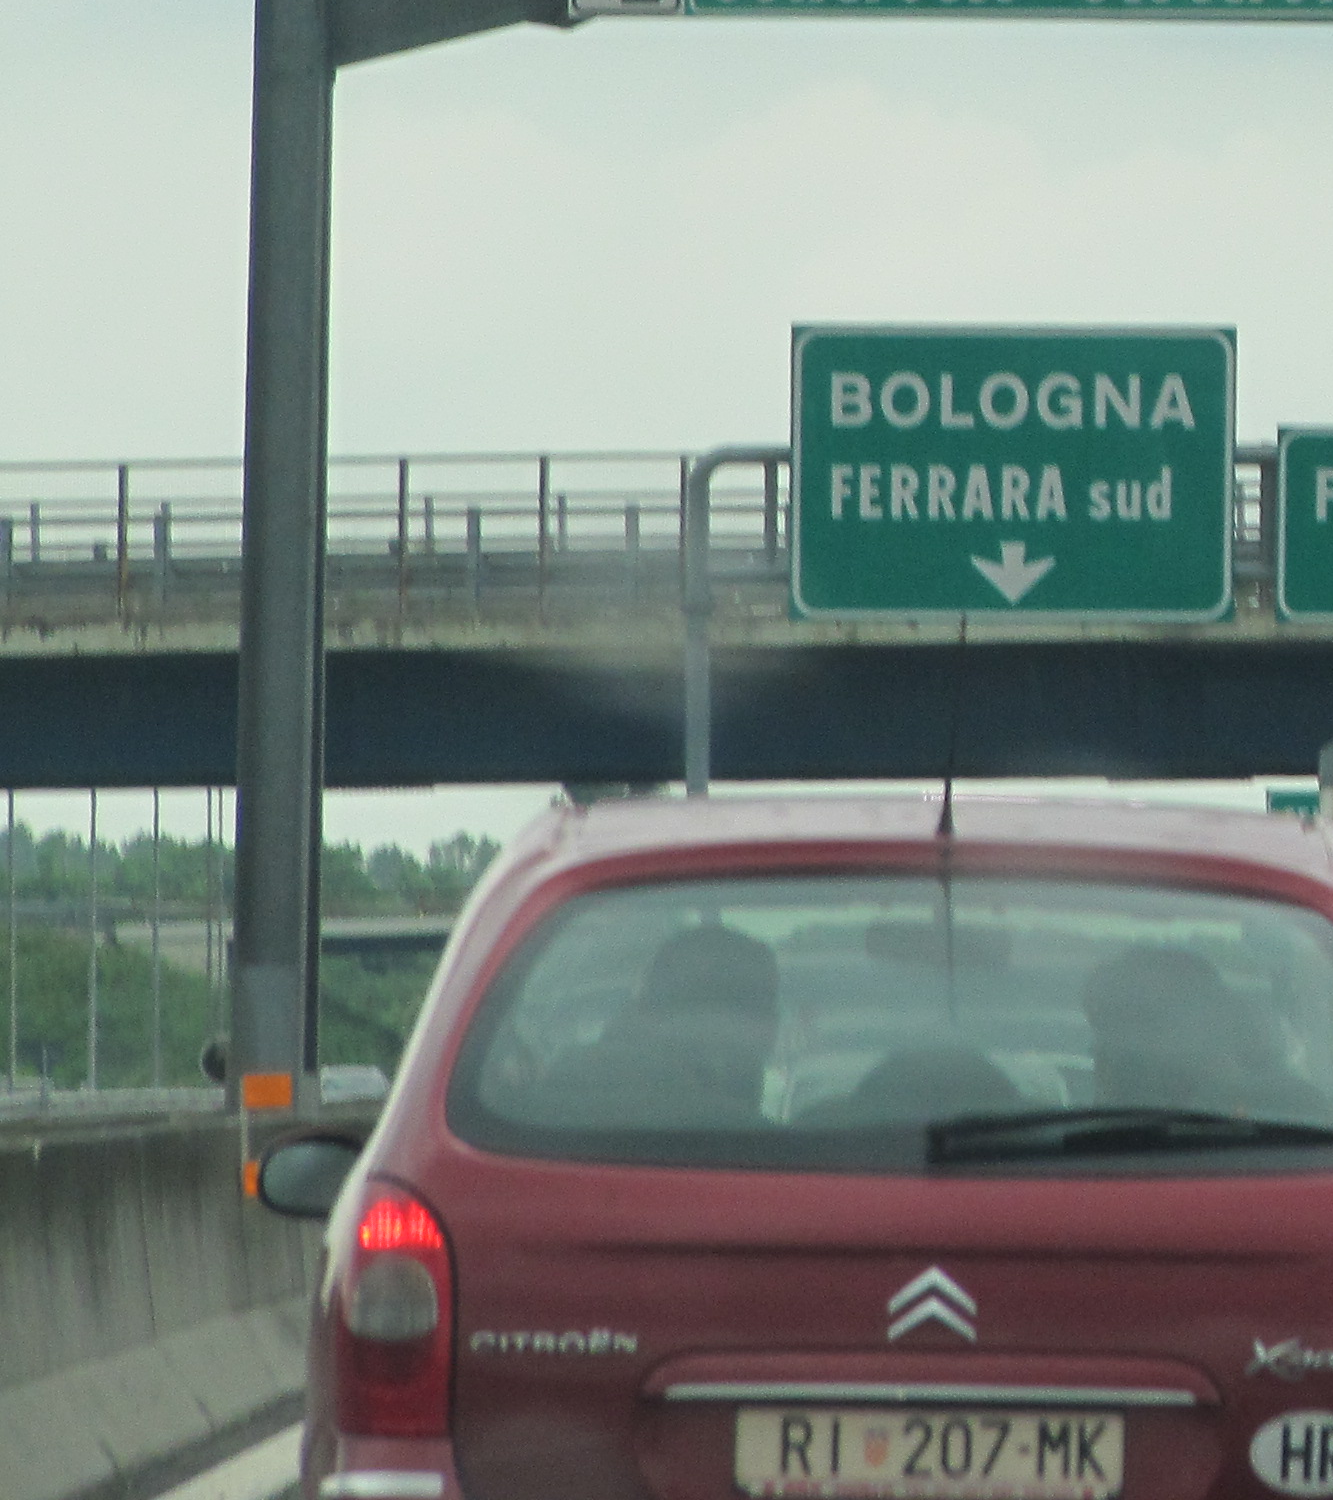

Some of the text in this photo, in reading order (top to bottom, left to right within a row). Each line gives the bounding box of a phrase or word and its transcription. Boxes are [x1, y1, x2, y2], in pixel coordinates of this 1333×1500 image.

[830, 371, 1196, 430] BOLOGNA
[830, 464, 1173, 520] FERRARA sud
[782, 1414, 841, 1476] RI
